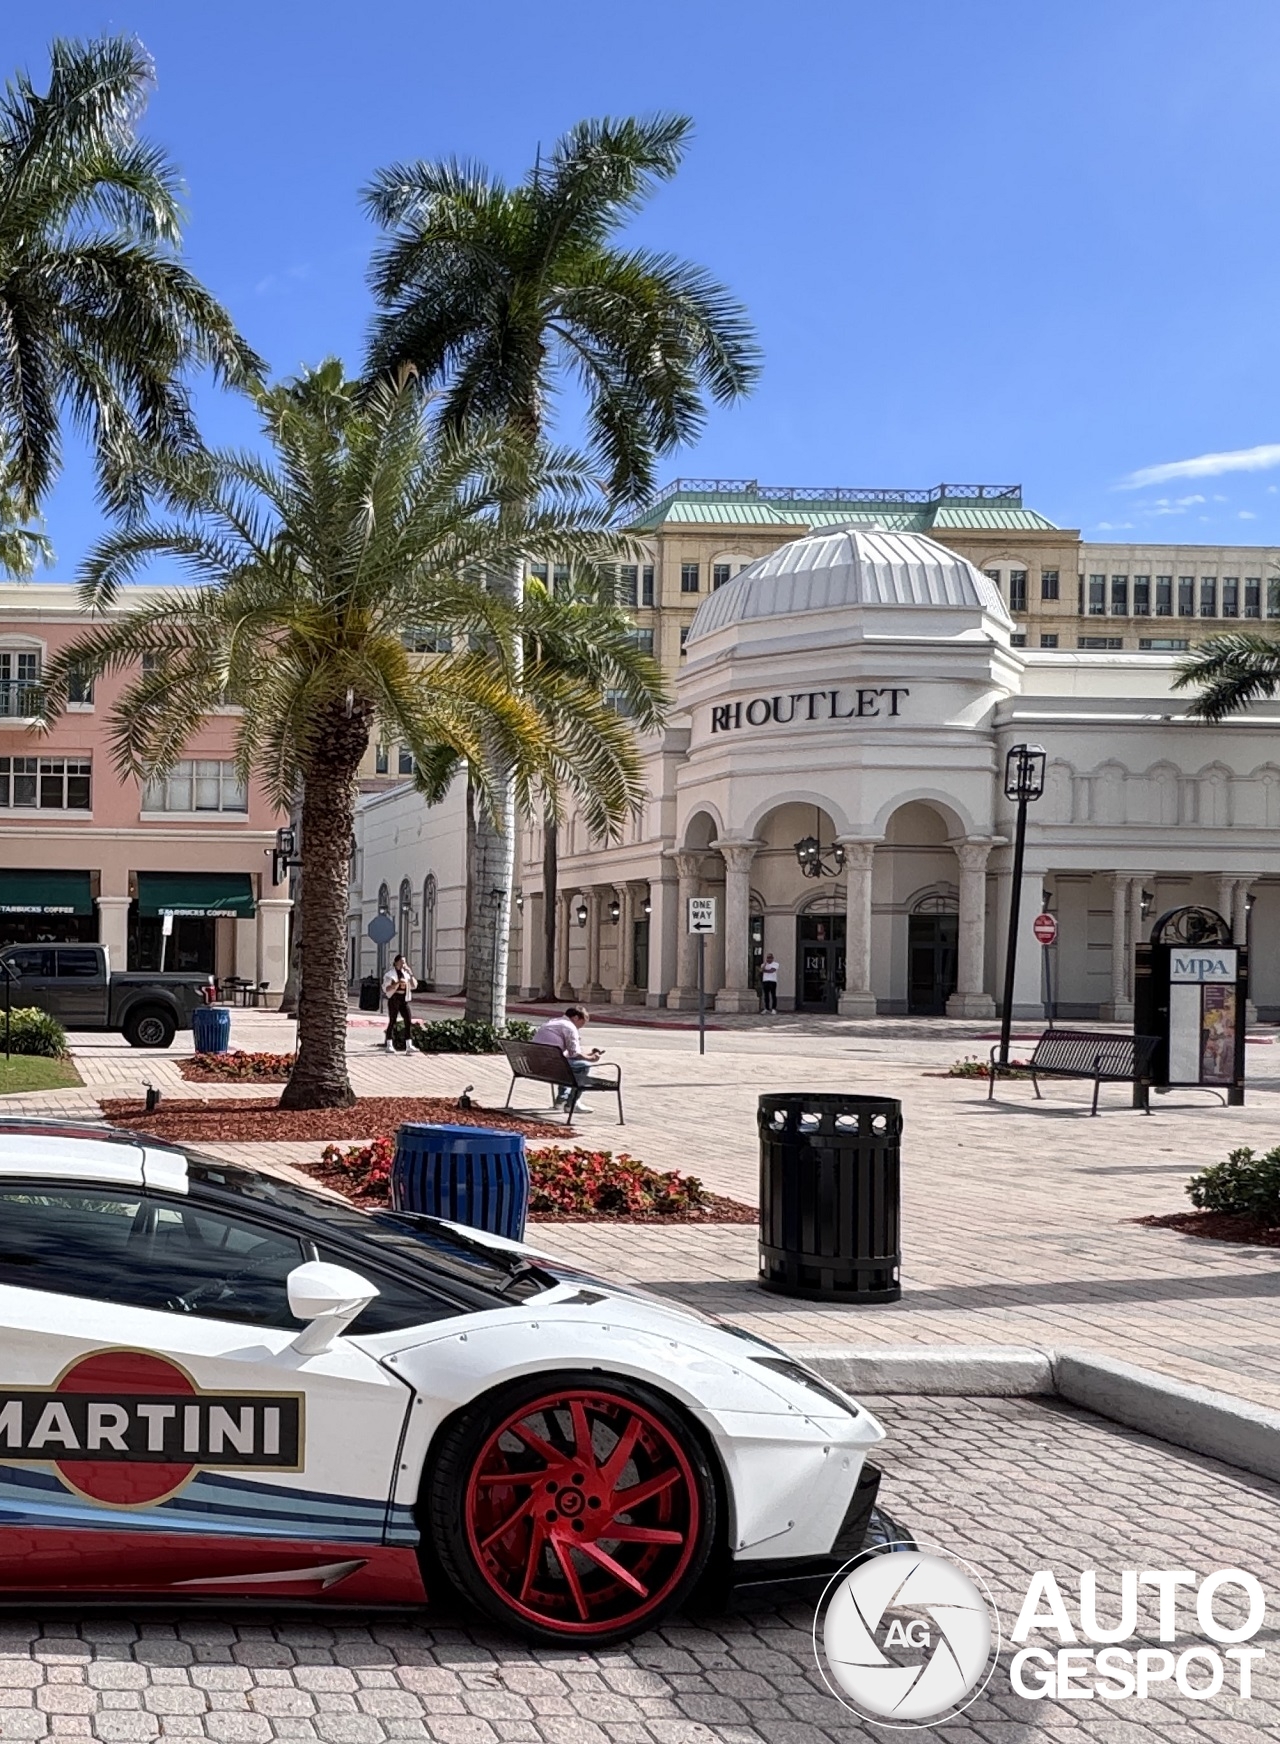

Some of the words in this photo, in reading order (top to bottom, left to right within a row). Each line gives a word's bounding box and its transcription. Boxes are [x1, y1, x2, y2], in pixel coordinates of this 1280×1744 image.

[711, 701, 742, 733] RH
[746, 688, 910, 726] OUTLET
[692, 900, 712, 909] ONE
[692, 911, 712, 919] WAY
